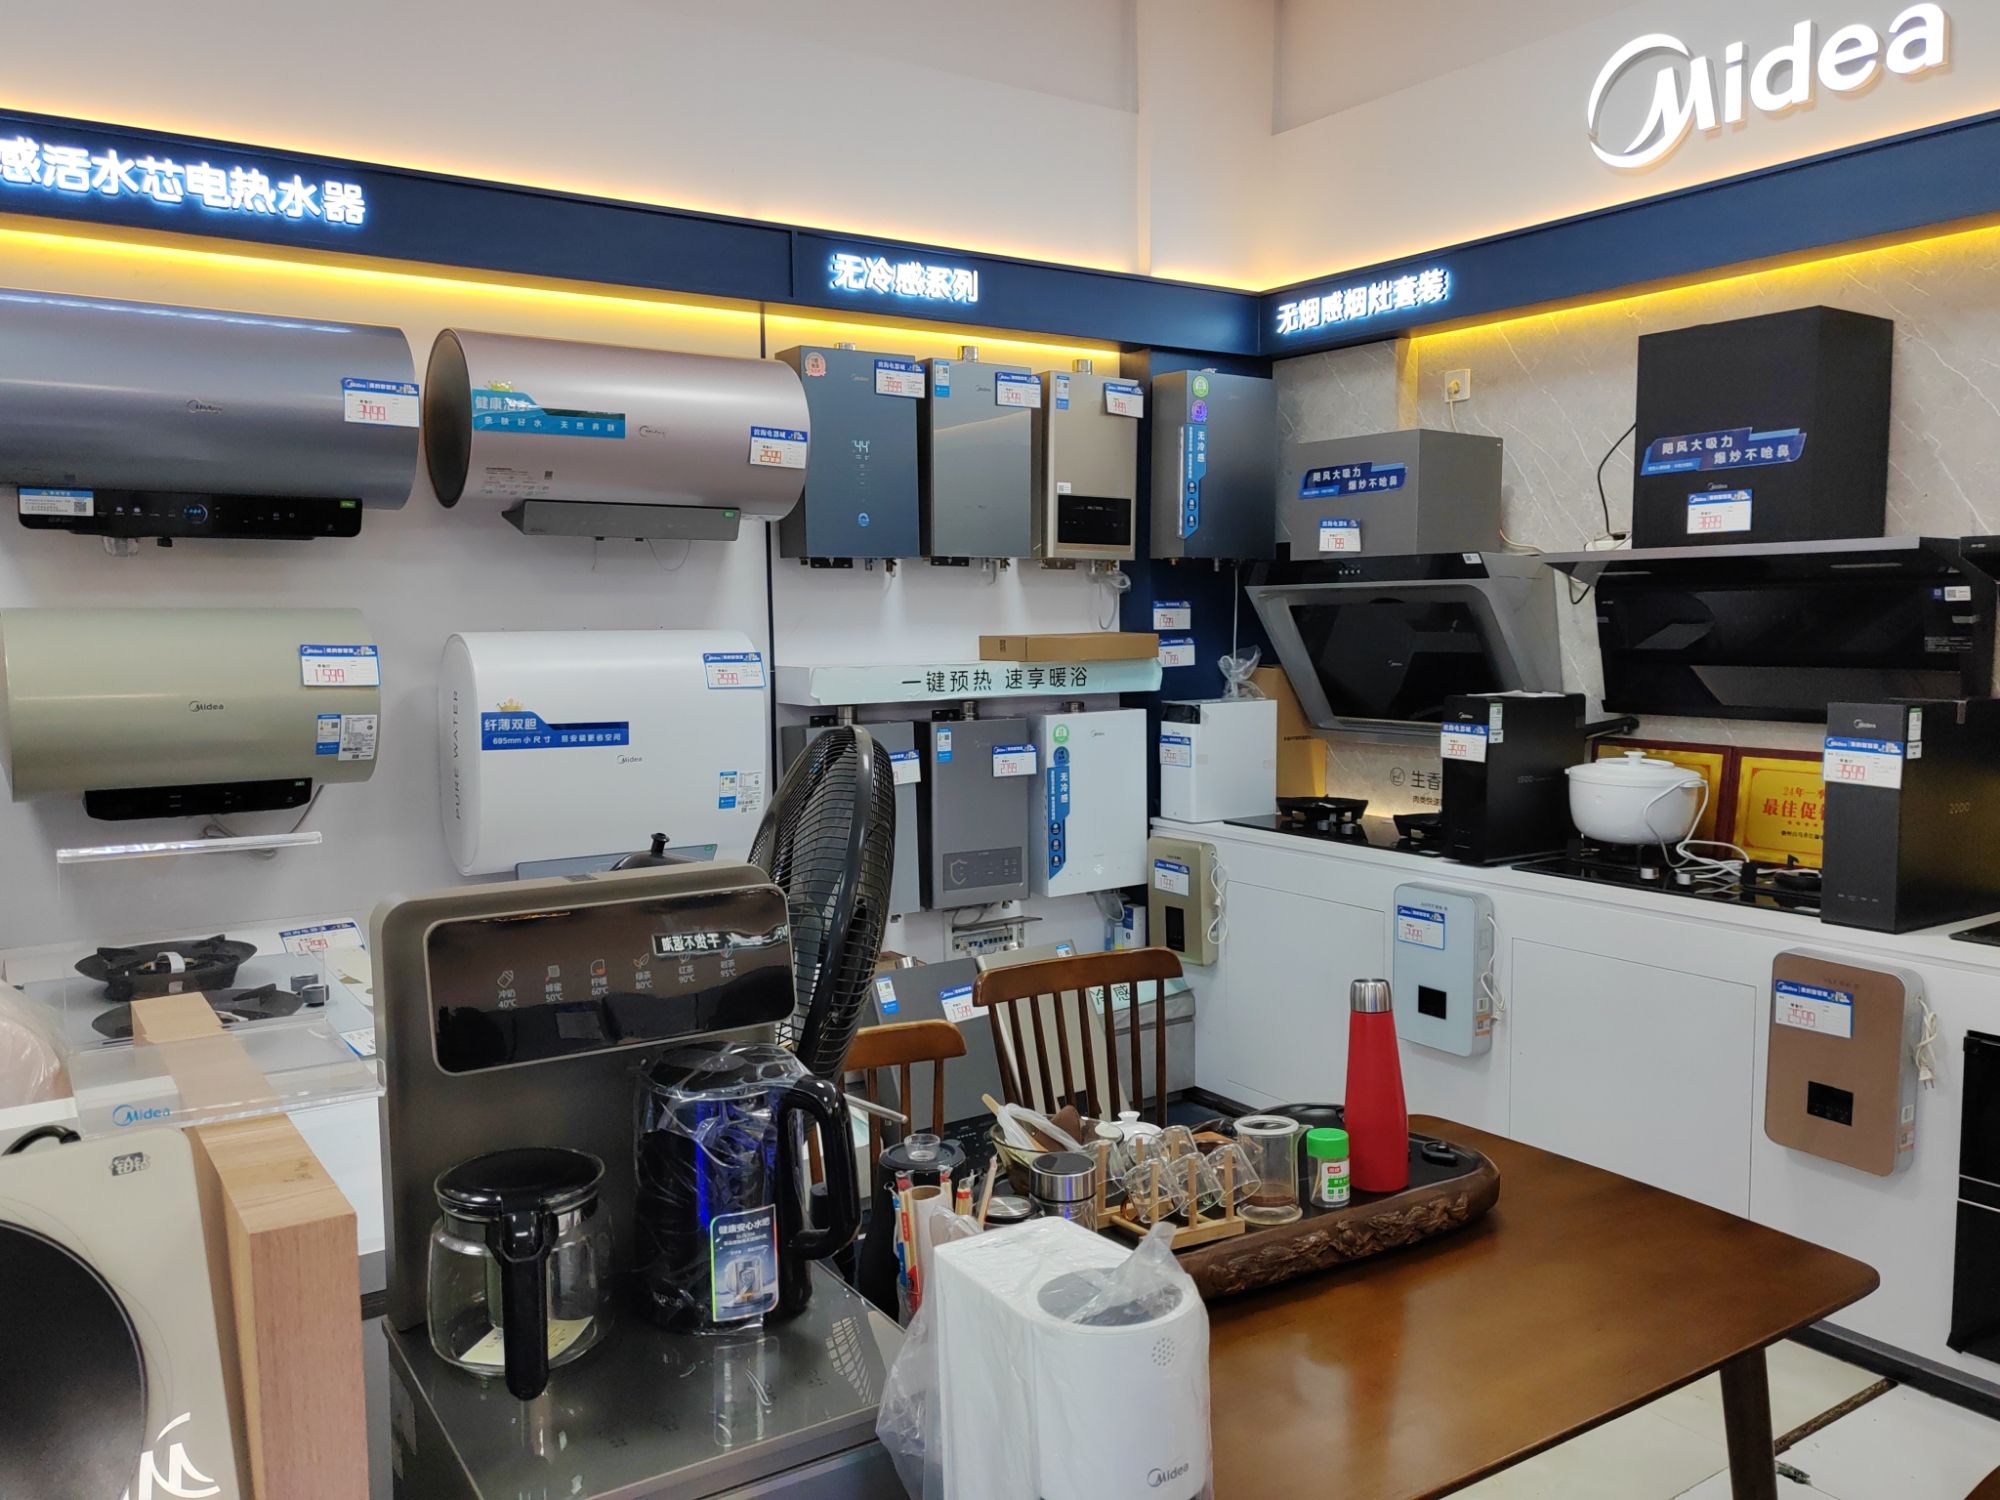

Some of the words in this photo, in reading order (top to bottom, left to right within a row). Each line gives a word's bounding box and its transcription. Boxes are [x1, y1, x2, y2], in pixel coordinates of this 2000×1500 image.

[1588, 3, 1948, 168] Midea
[832, 253, 980, 303] 无冷感系列
[1277, 267, 1449, 334] 无烟感烟灶套装
[315, 668, 345, 683] 1599
[902, 669, 992, 692] 一键预热
[1004, 666, 1087, 690] 速享暖浴
[189, 700, 224, 713] Midea
[484, 717, 536, 732] 纤薄双胆
[112, 1104, 172, 1127] Midea
[1146, 1462, 1189, 1488] Midea
